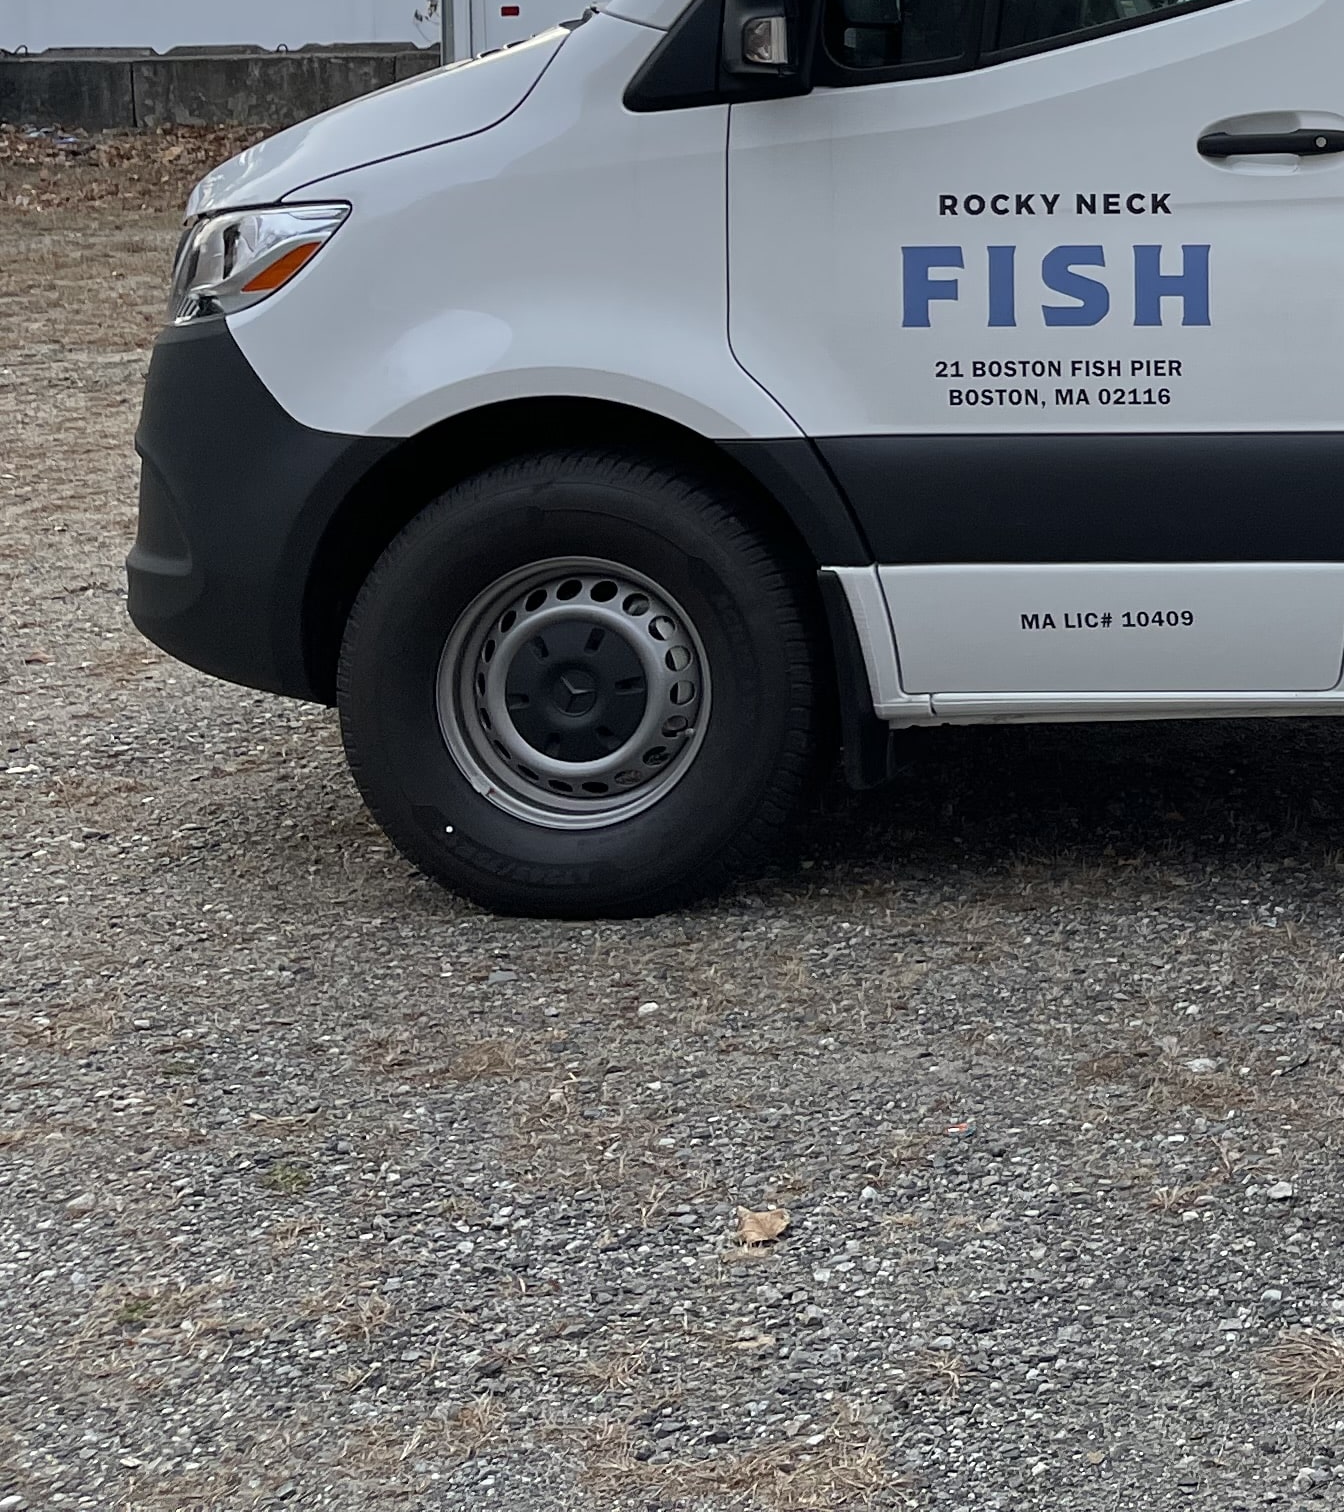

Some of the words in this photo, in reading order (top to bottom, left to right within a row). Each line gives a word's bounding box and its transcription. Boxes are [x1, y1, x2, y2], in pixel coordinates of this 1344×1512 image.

[939, 193, 1060, 216] ROCKY
[1076, 193, 1172, 215] NECK
[901, 244, 1212, 328] FISH
[935, 361, 964, 378] 21
[972, 361, 1062, 378] BOSTON
[1071, 360, 1121, 377] FISH
[1130, 360, 1182, 377] PIER
[949, 389, 1046, 409] BOSTON,
[1055, 389, 1090, 406] MA
[1098, 388, 1171, 405] 02116
[1020, 614, 1056, 630] MA
[1064, 612, 1113, 629] LIC#
[1121, 611, 1194, 627] 10409
